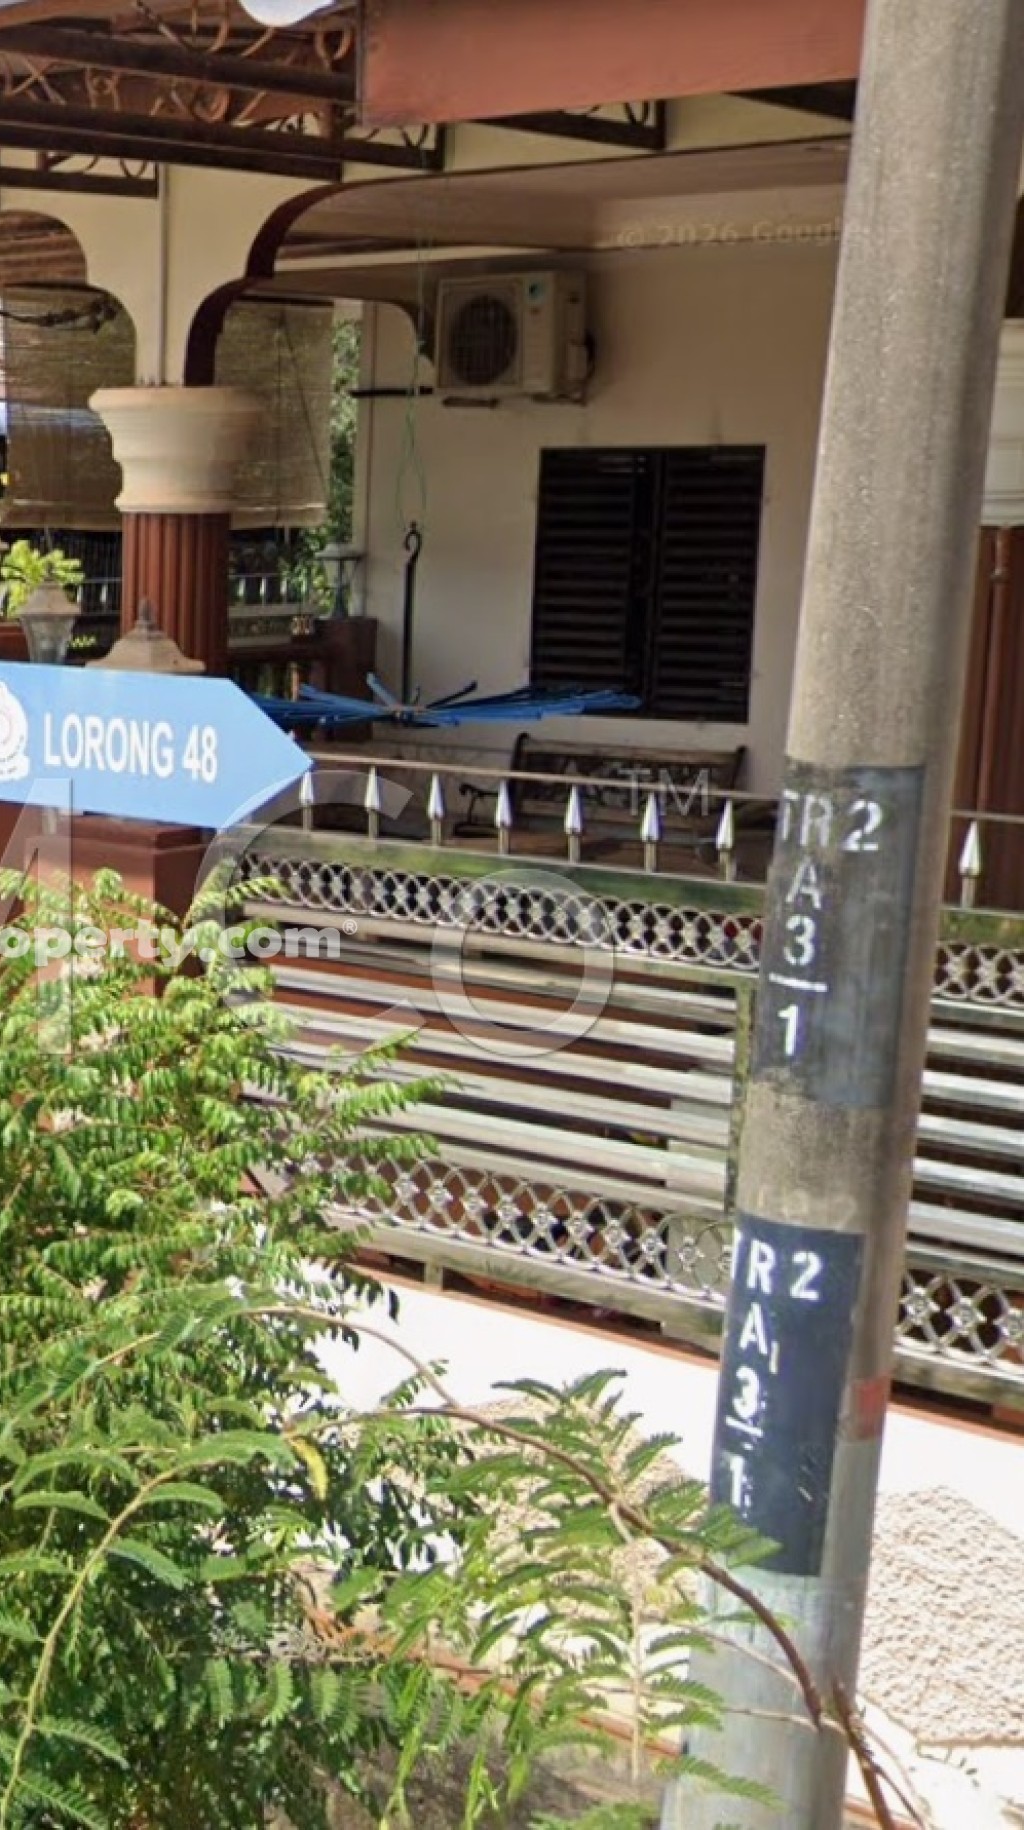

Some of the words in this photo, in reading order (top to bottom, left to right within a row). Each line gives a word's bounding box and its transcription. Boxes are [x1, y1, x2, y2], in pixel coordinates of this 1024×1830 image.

[42, 713, 174, 778] LORONG
[182, 724, 218, 783] 48
[782, 789, 833, 848] TR
[842, 800, 882, 852] 2
[786, 857, 821, 909] A
[783, 915, 816, 967] 3
[777, 1004, 800, 1057] 1
[789, 1250, 823, 1300] 2
[739, 1301, 768, 1355] A
[732, 1365, 761, 1420] 3
[728, 1452, 747, 1507] 1
